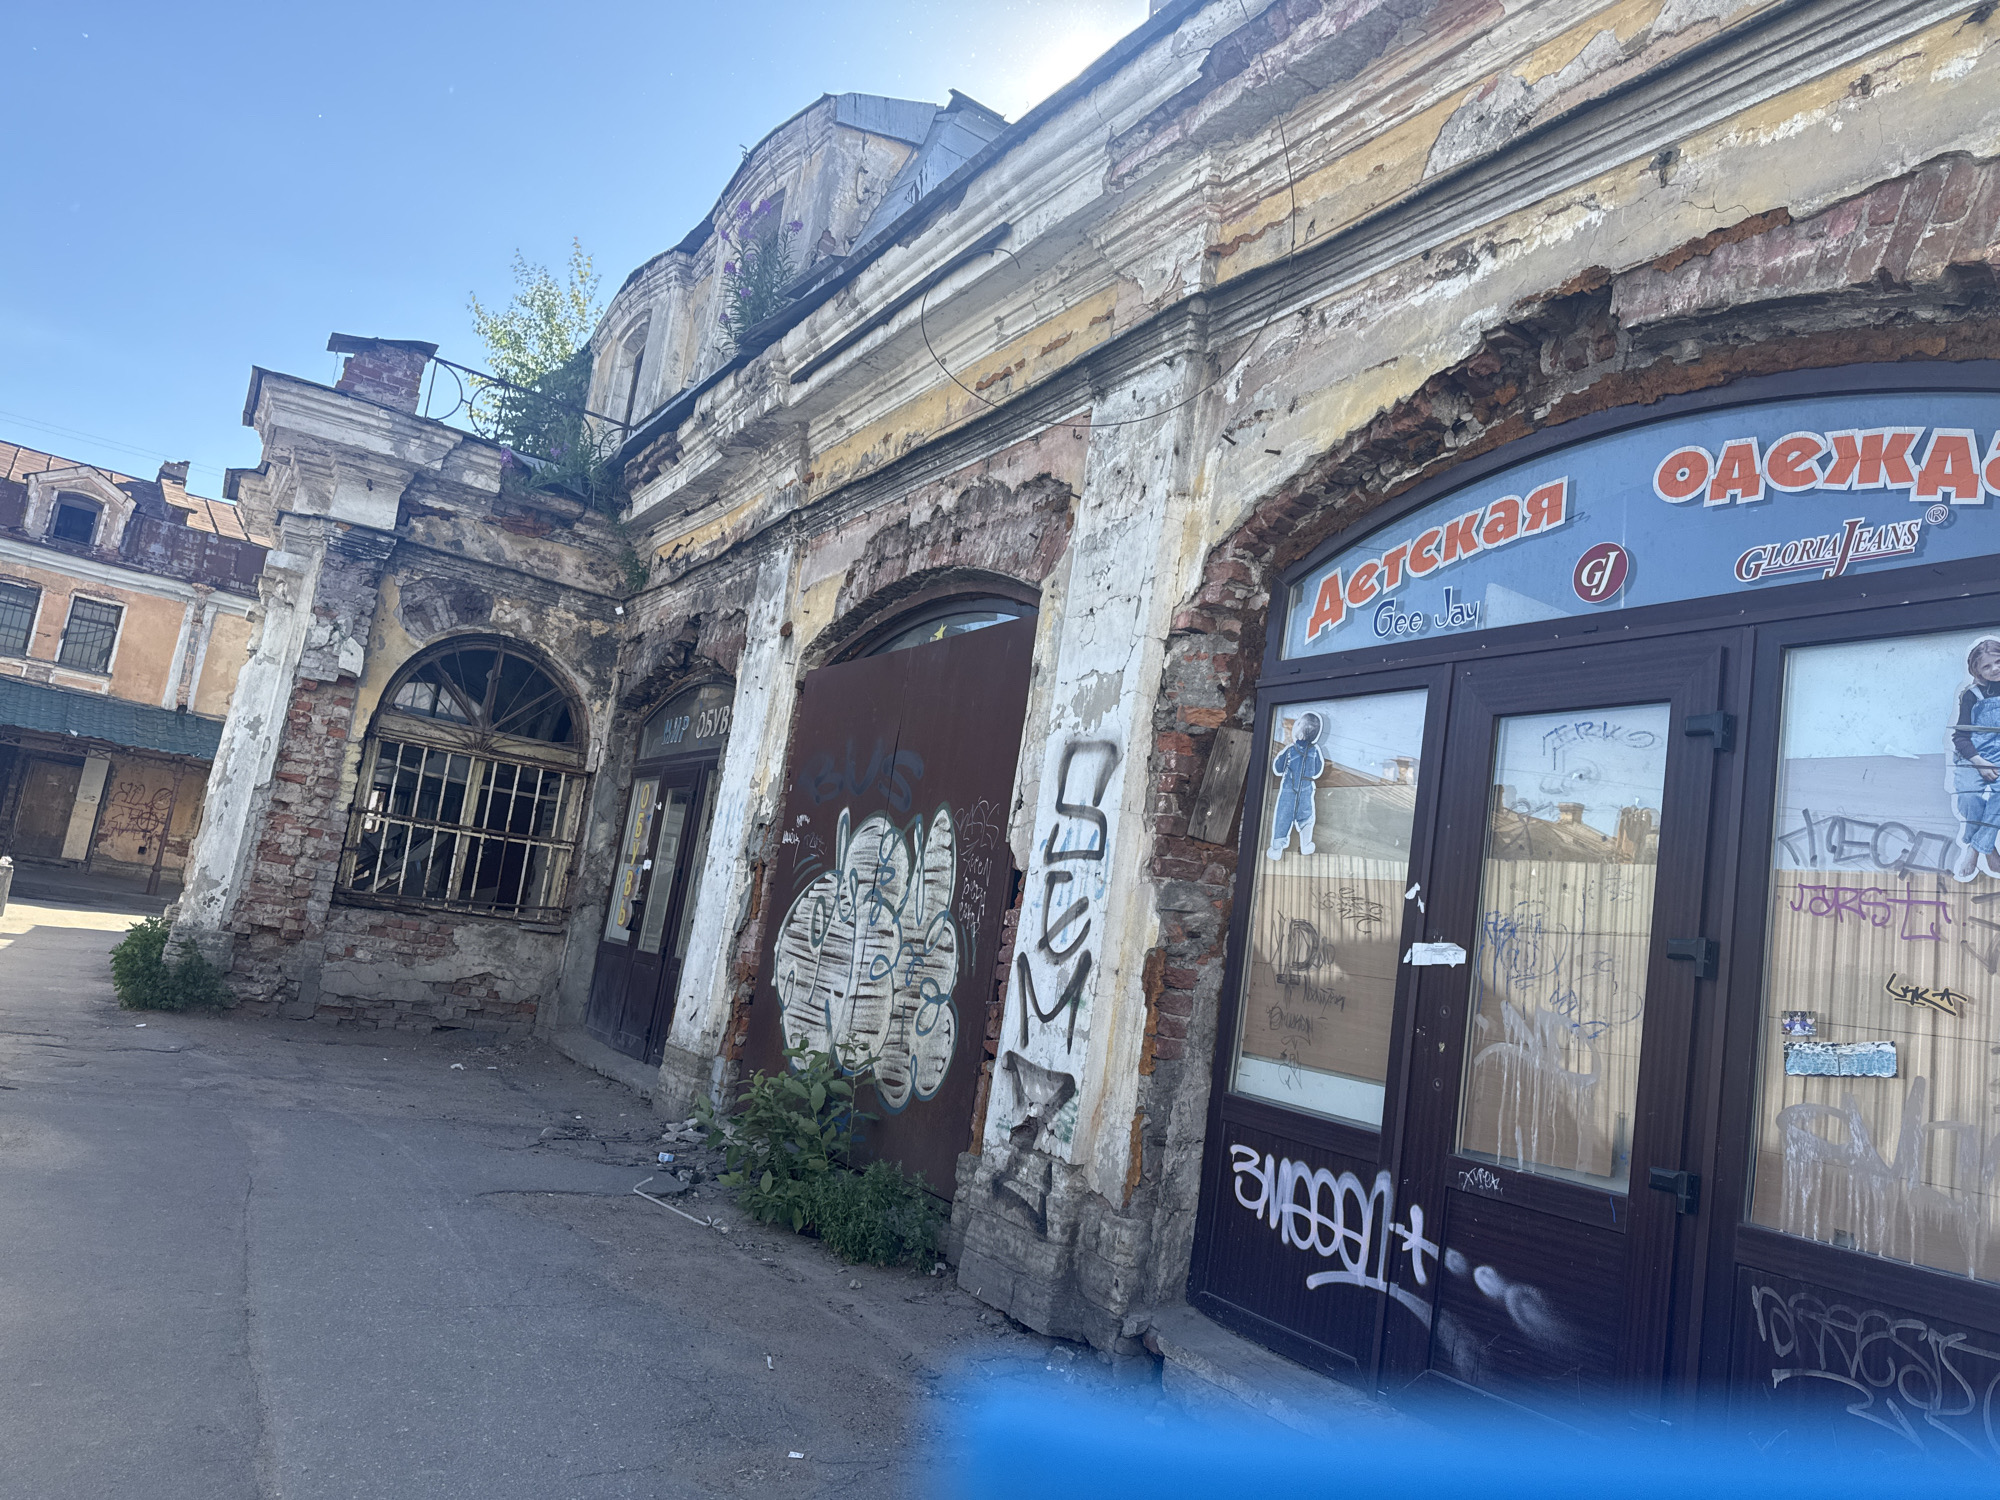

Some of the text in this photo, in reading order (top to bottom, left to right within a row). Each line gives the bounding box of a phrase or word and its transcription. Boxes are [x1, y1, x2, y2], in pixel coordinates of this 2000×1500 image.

[1305, 475, 1568, 645] Детская
[1580, 550, 1621, 597] GJ
[1734, 531, 1843, 583] GLORIA
[1372, 585, 1481, 639] Gee Jay
[695, 705, 733, 739] ОБУВ
[616, 783, 650, 926] ОБУВЬ
